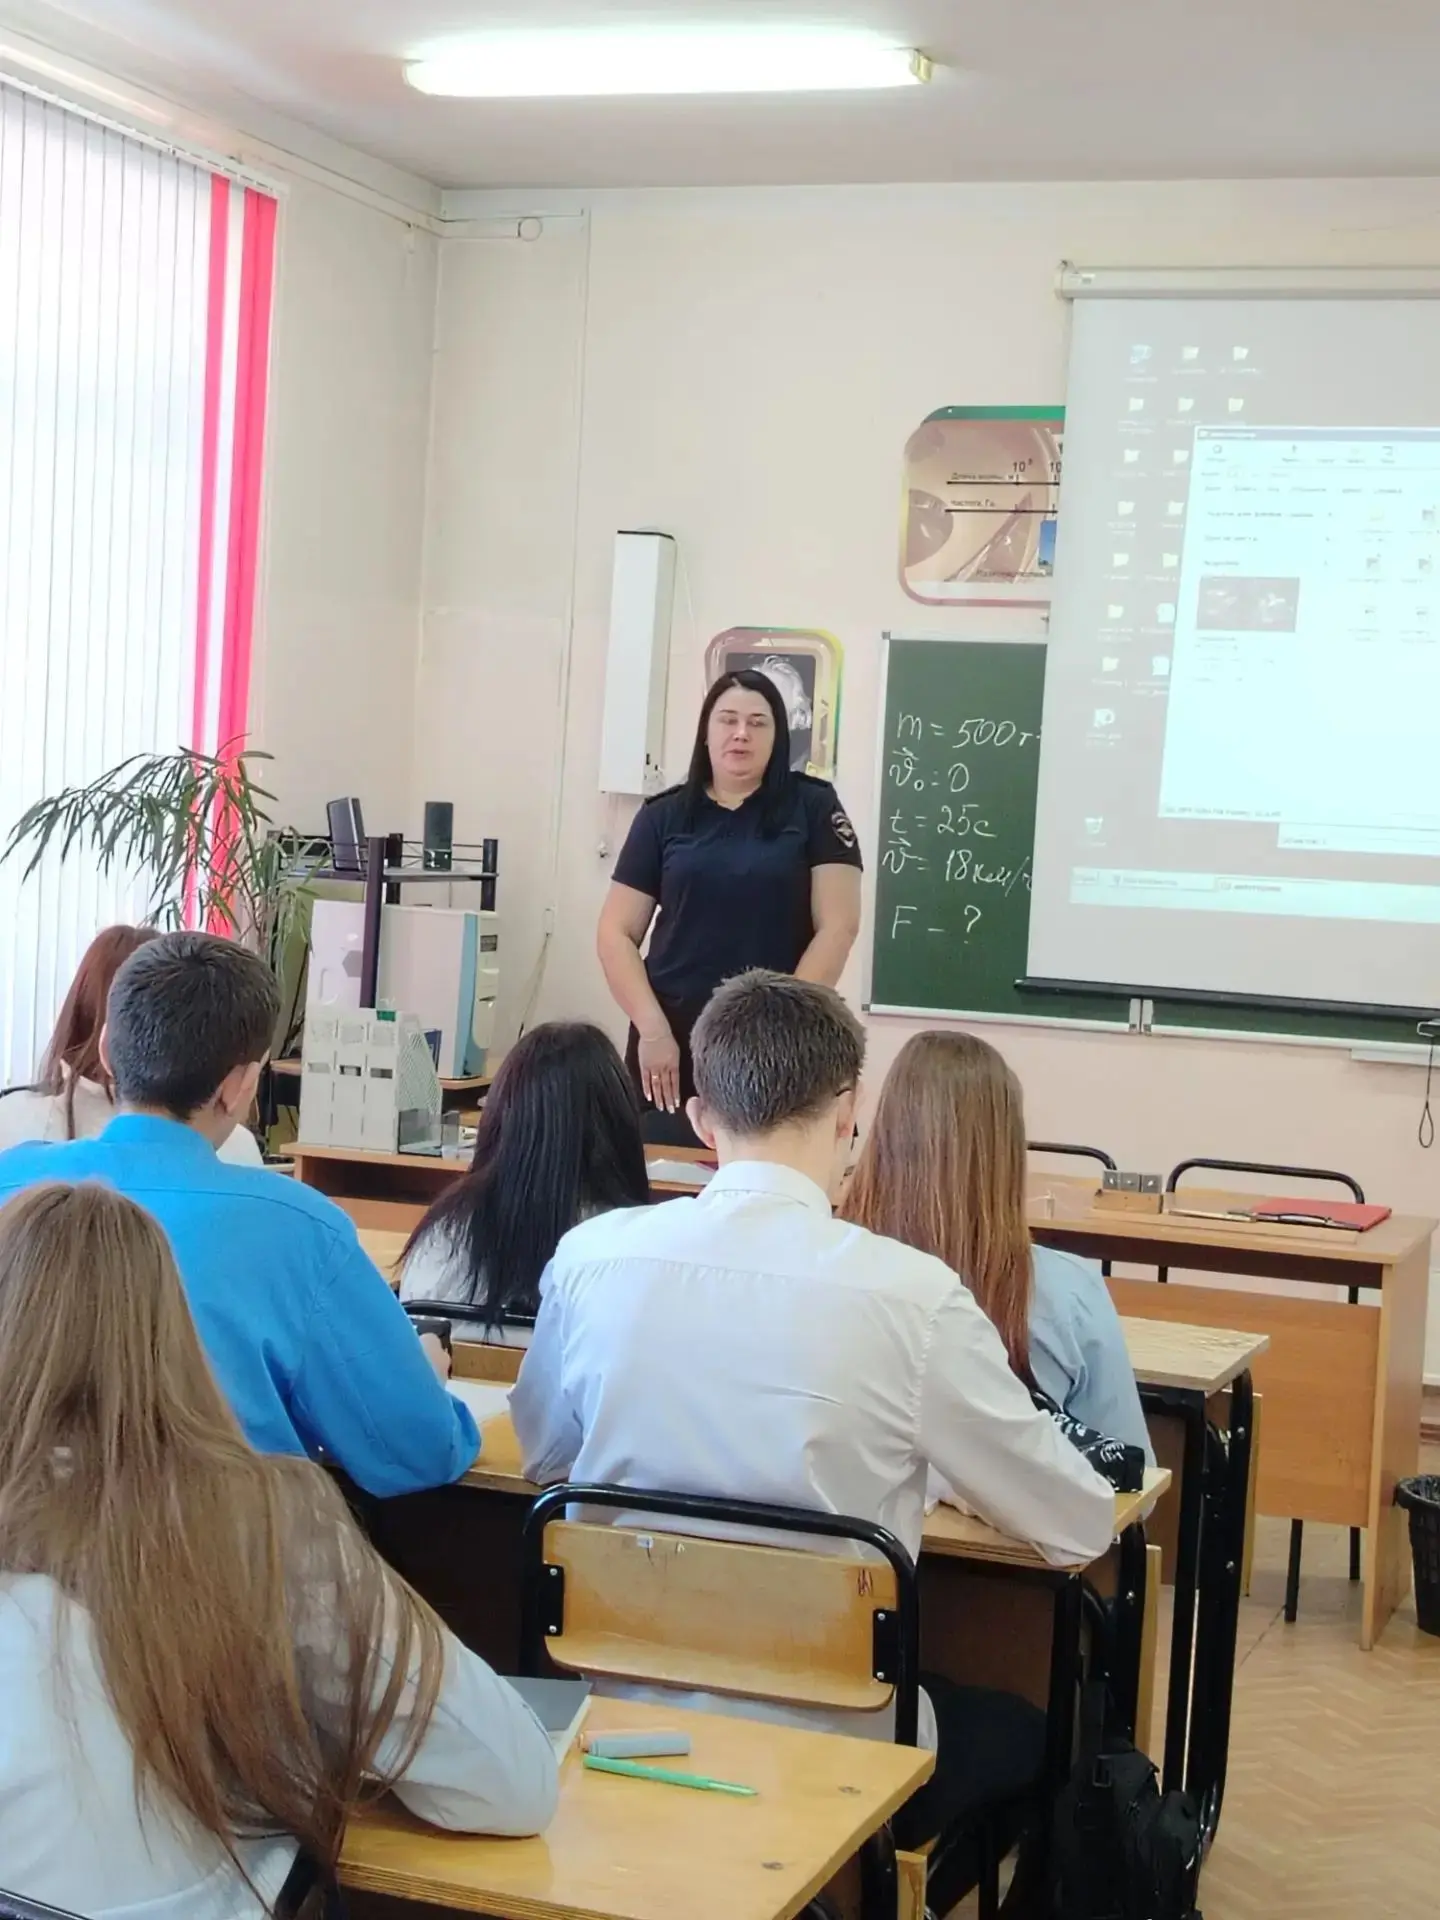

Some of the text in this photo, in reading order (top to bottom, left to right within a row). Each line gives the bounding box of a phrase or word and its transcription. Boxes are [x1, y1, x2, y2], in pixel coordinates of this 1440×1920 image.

[930, 723, 945, 736] =
[889, 808, 908, 834] t
[915, 814, 928, 828] =
[892, 905, 918, 939] F
[963, 904, 982, 944] ?
